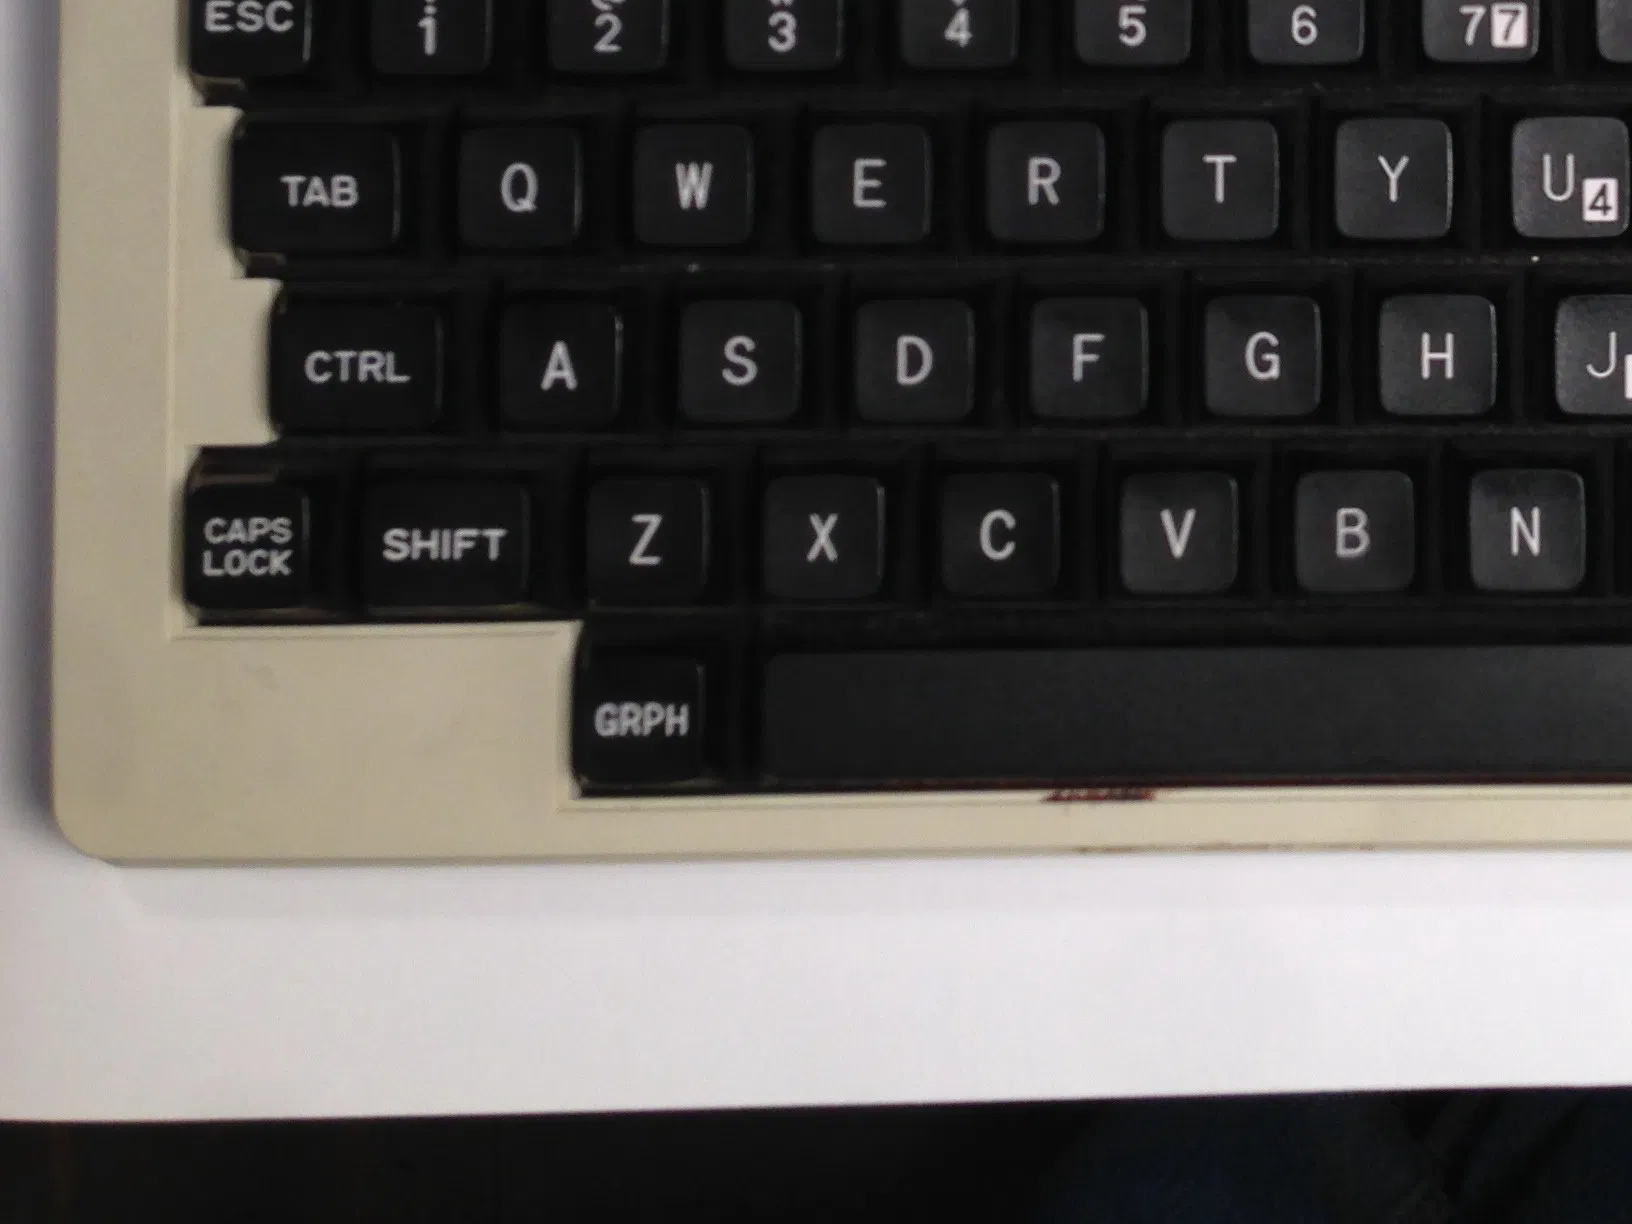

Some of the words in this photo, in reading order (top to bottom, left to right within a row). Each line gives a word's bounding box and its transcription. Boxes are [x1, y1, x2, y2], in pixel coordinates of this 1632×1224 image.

[205, 0, 293, 33] ESC
[418, 14, 436, 55] 1
[594, 12, 622, 53] 2
[768, 11, 797, 52] 3
[944, 8, 972, 47] 4
[1119, 5, 1147, 47] 5
[1291, 5, 1318, 45] 6
[1459, 5, 1486, 46] 7
[1498, 8, 1522, 42] 7
[280, 174, 359, 208] TAB
[500, 162, 538, 213] Q
[675, 162, 713, 209] W
[853, 158, 886, 208] E
[1028, 156, 1061, 205] R
[1203, 154, 1237, 203] T
[1377, 155, 1409, 203] Y
[1543, 153, 1575, 202] U
[1588, 184, 1612, 215] 4
[304, 350, 411, 384] CTRL
[541, 341, 577, 390] A
[722, 335, 758, 386] S
[896, 335, 933, 386] D
[1072, 333, 1105, 382] F
[1245, 331, 1280, 380] G
[1421, 332, 1454, 379] H
[1586, 331, 1617, 379] J
[204, 517, 292, 545] CAPS
[382, 527, 507, 562] SHIFT
[629, 513, 662, 565] Z
[806, 514, 838, 562] X
[979, 509, 1016, 561] C
[1160, 508, 1196, 558] V
[1336, 507, 1370, 558] B
[1511, 507, 1540, 556] N
[203, 548, 292, 577] LOCK
[594, 701, 689, 737] GRPH
